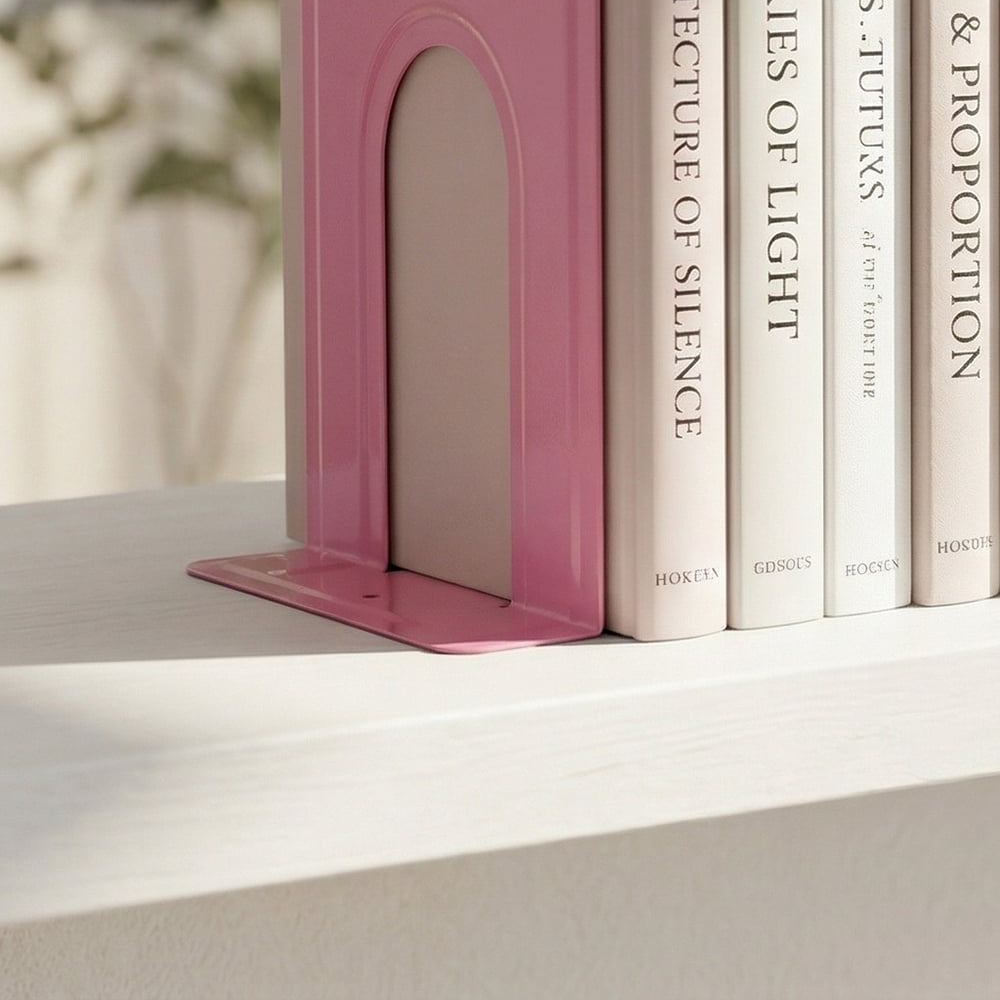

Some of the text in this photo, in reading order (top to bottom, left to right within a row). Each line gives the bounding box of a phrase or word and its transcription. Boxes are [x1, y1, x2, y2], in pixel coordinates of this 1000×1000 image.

[951, 13, 984, 48] &
[767, 100, 800, 165] OF
[674, 195, 702, 250] OF
[768, 184, 800, 340] LIGHT
[951, 64, 984, 380] PROPORTION
[675, 264, 703, 440] SILENCE
